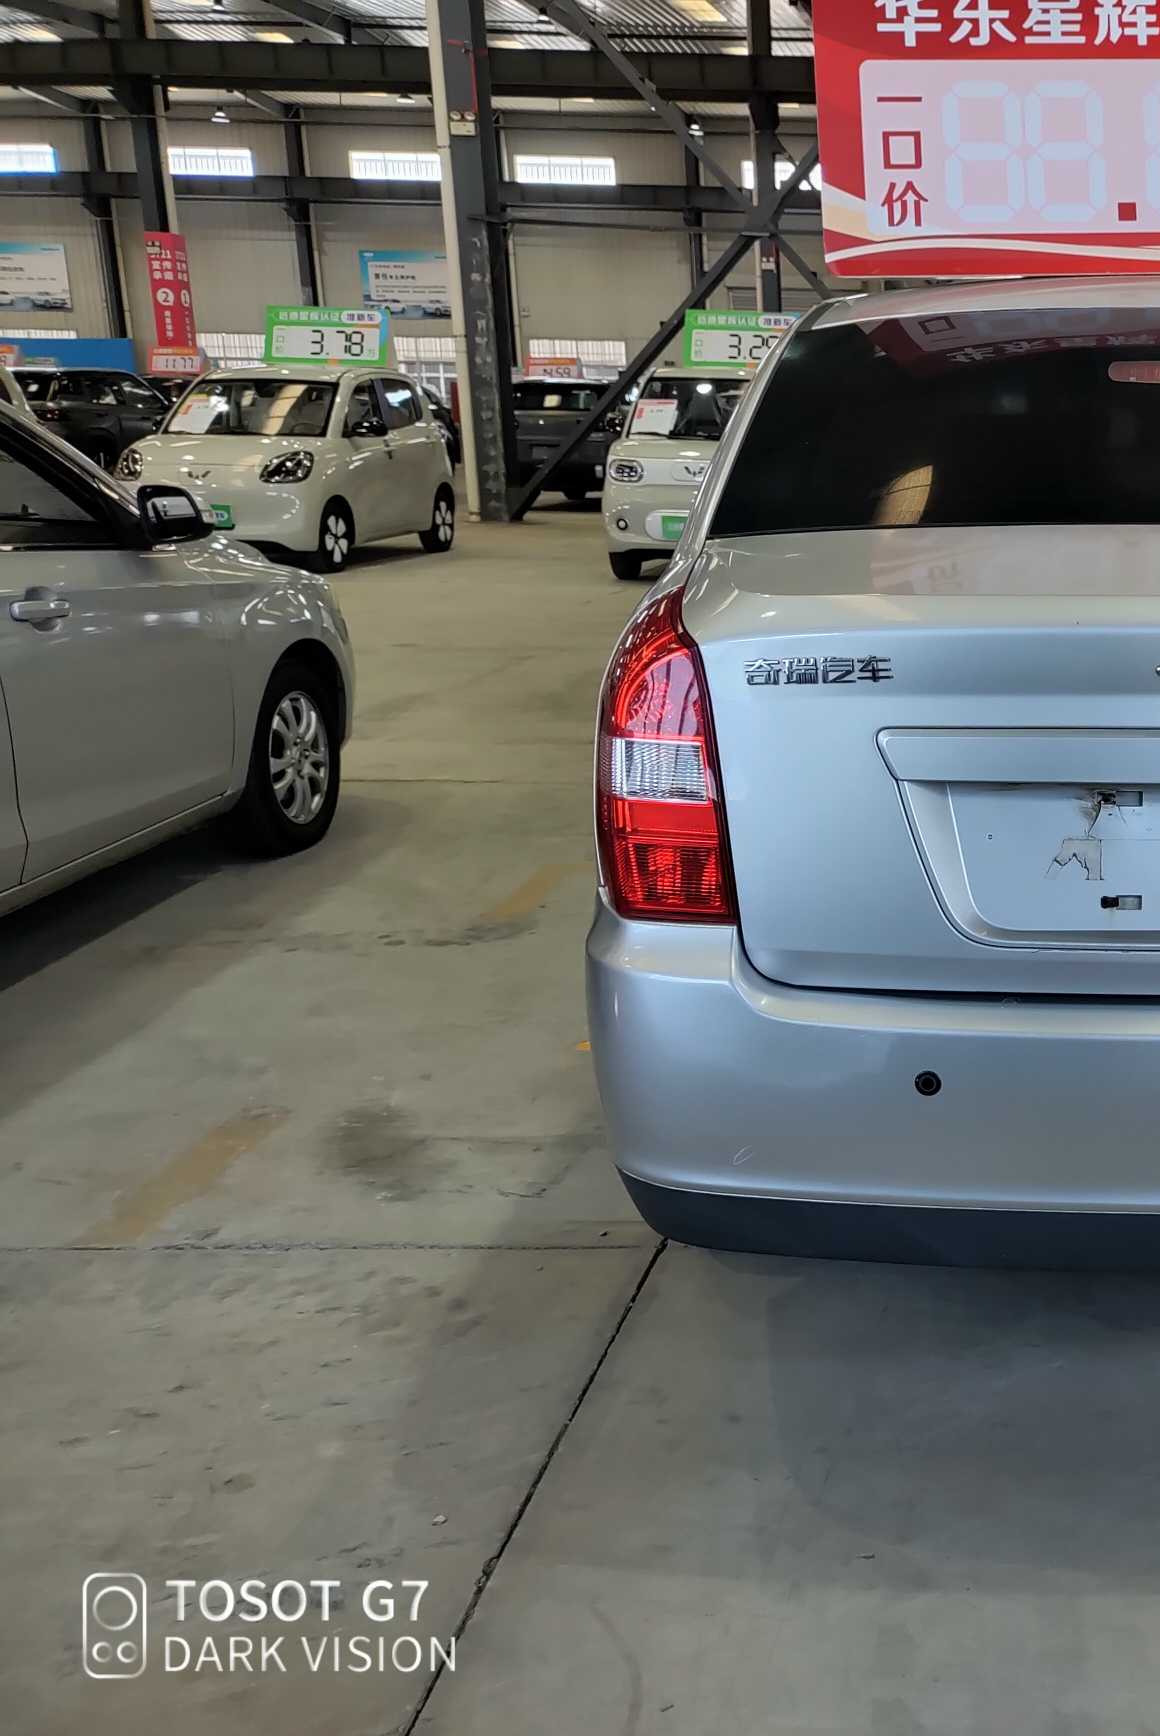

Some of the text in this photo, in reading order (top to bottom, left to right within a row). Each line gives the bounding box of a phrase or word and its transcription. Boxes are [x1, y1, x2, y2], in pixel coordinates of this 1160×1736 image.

[876, 94, 928, 228] 一口价
[309, 329, 364, 357] 3.78
[744, 655, 894, 686] 奇瑞汽车
